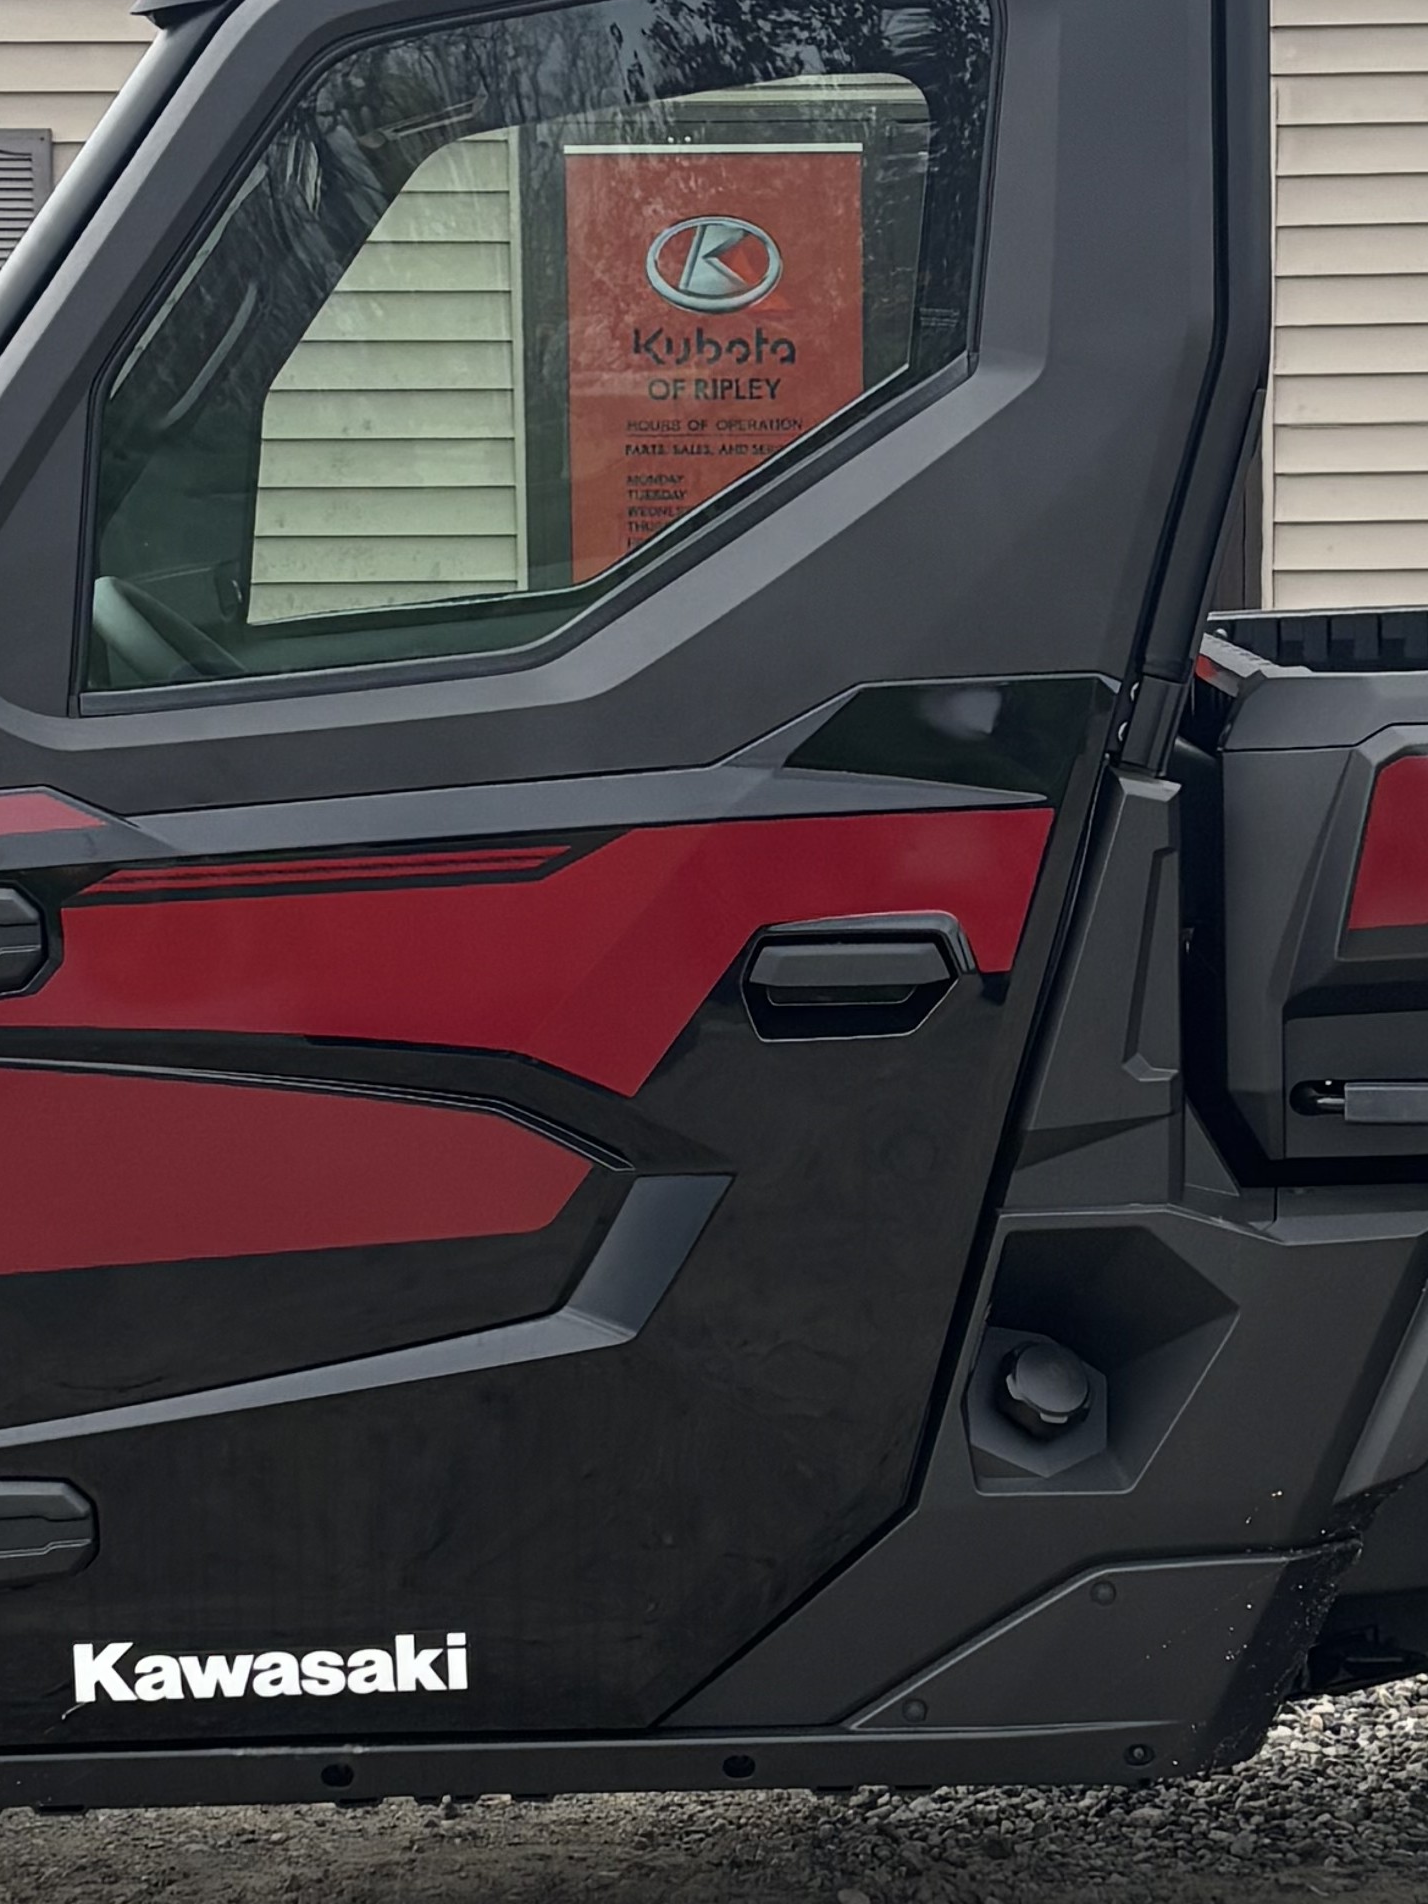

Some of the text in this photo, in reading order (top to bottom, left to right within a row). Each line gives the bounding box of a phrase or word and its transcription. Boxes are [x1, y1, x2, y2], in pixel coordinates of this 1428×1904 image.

[632, 327, 797, 365] Kubota
[648, 378, 782, 400] OF RIPLEY
[626, 417, 804, 433] HOURS OF OPERATION
[73, 1632, 469, 1704] Kawasaki
